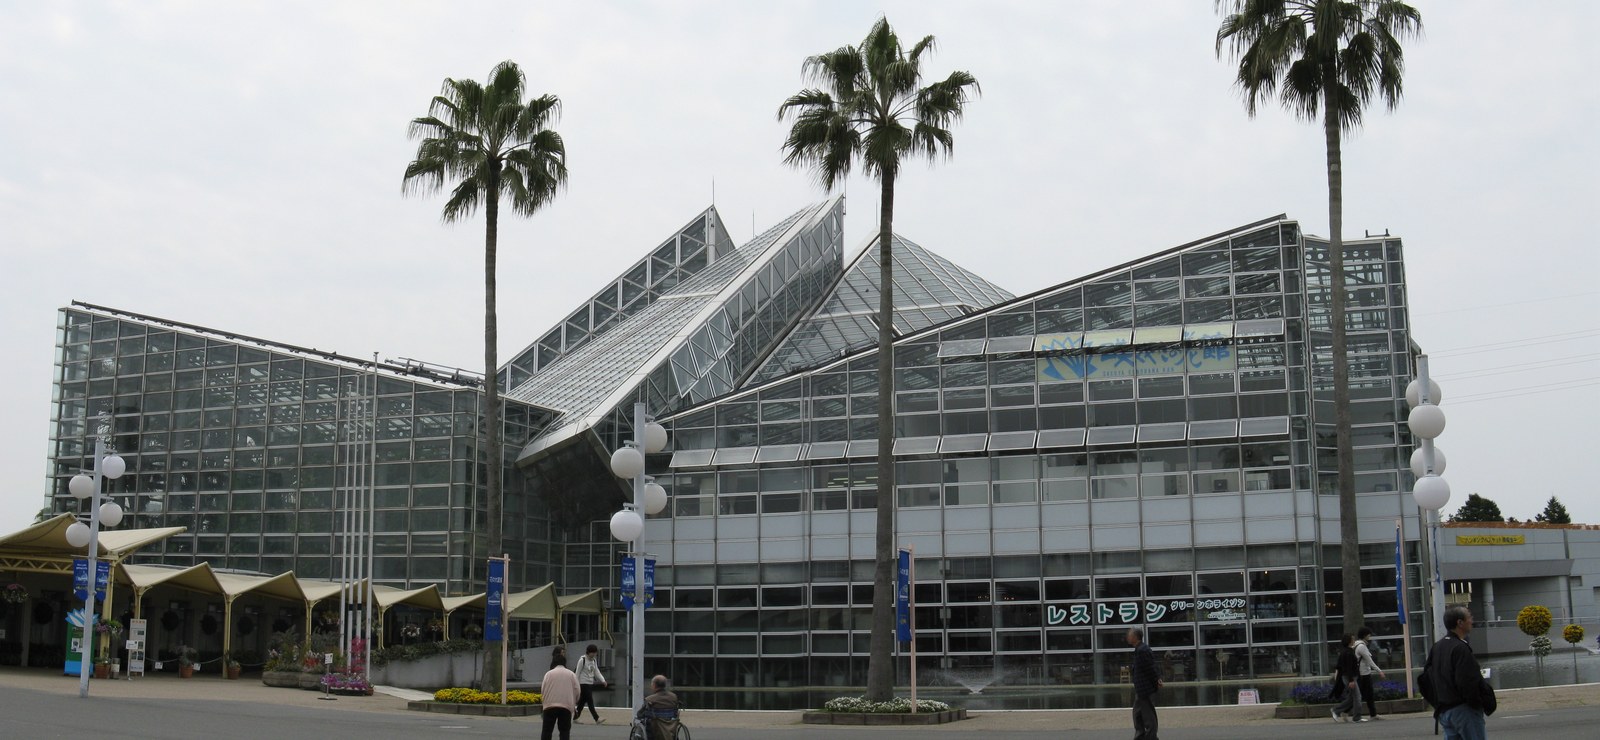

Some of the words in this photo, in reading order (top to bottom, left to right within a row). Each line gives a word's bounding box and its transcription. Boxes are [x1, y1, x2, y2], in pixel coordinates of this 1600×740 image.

[1048, 602, 1167, 624] レストラン
[1170, 598, 1246, 611] グリーンホライゾン
